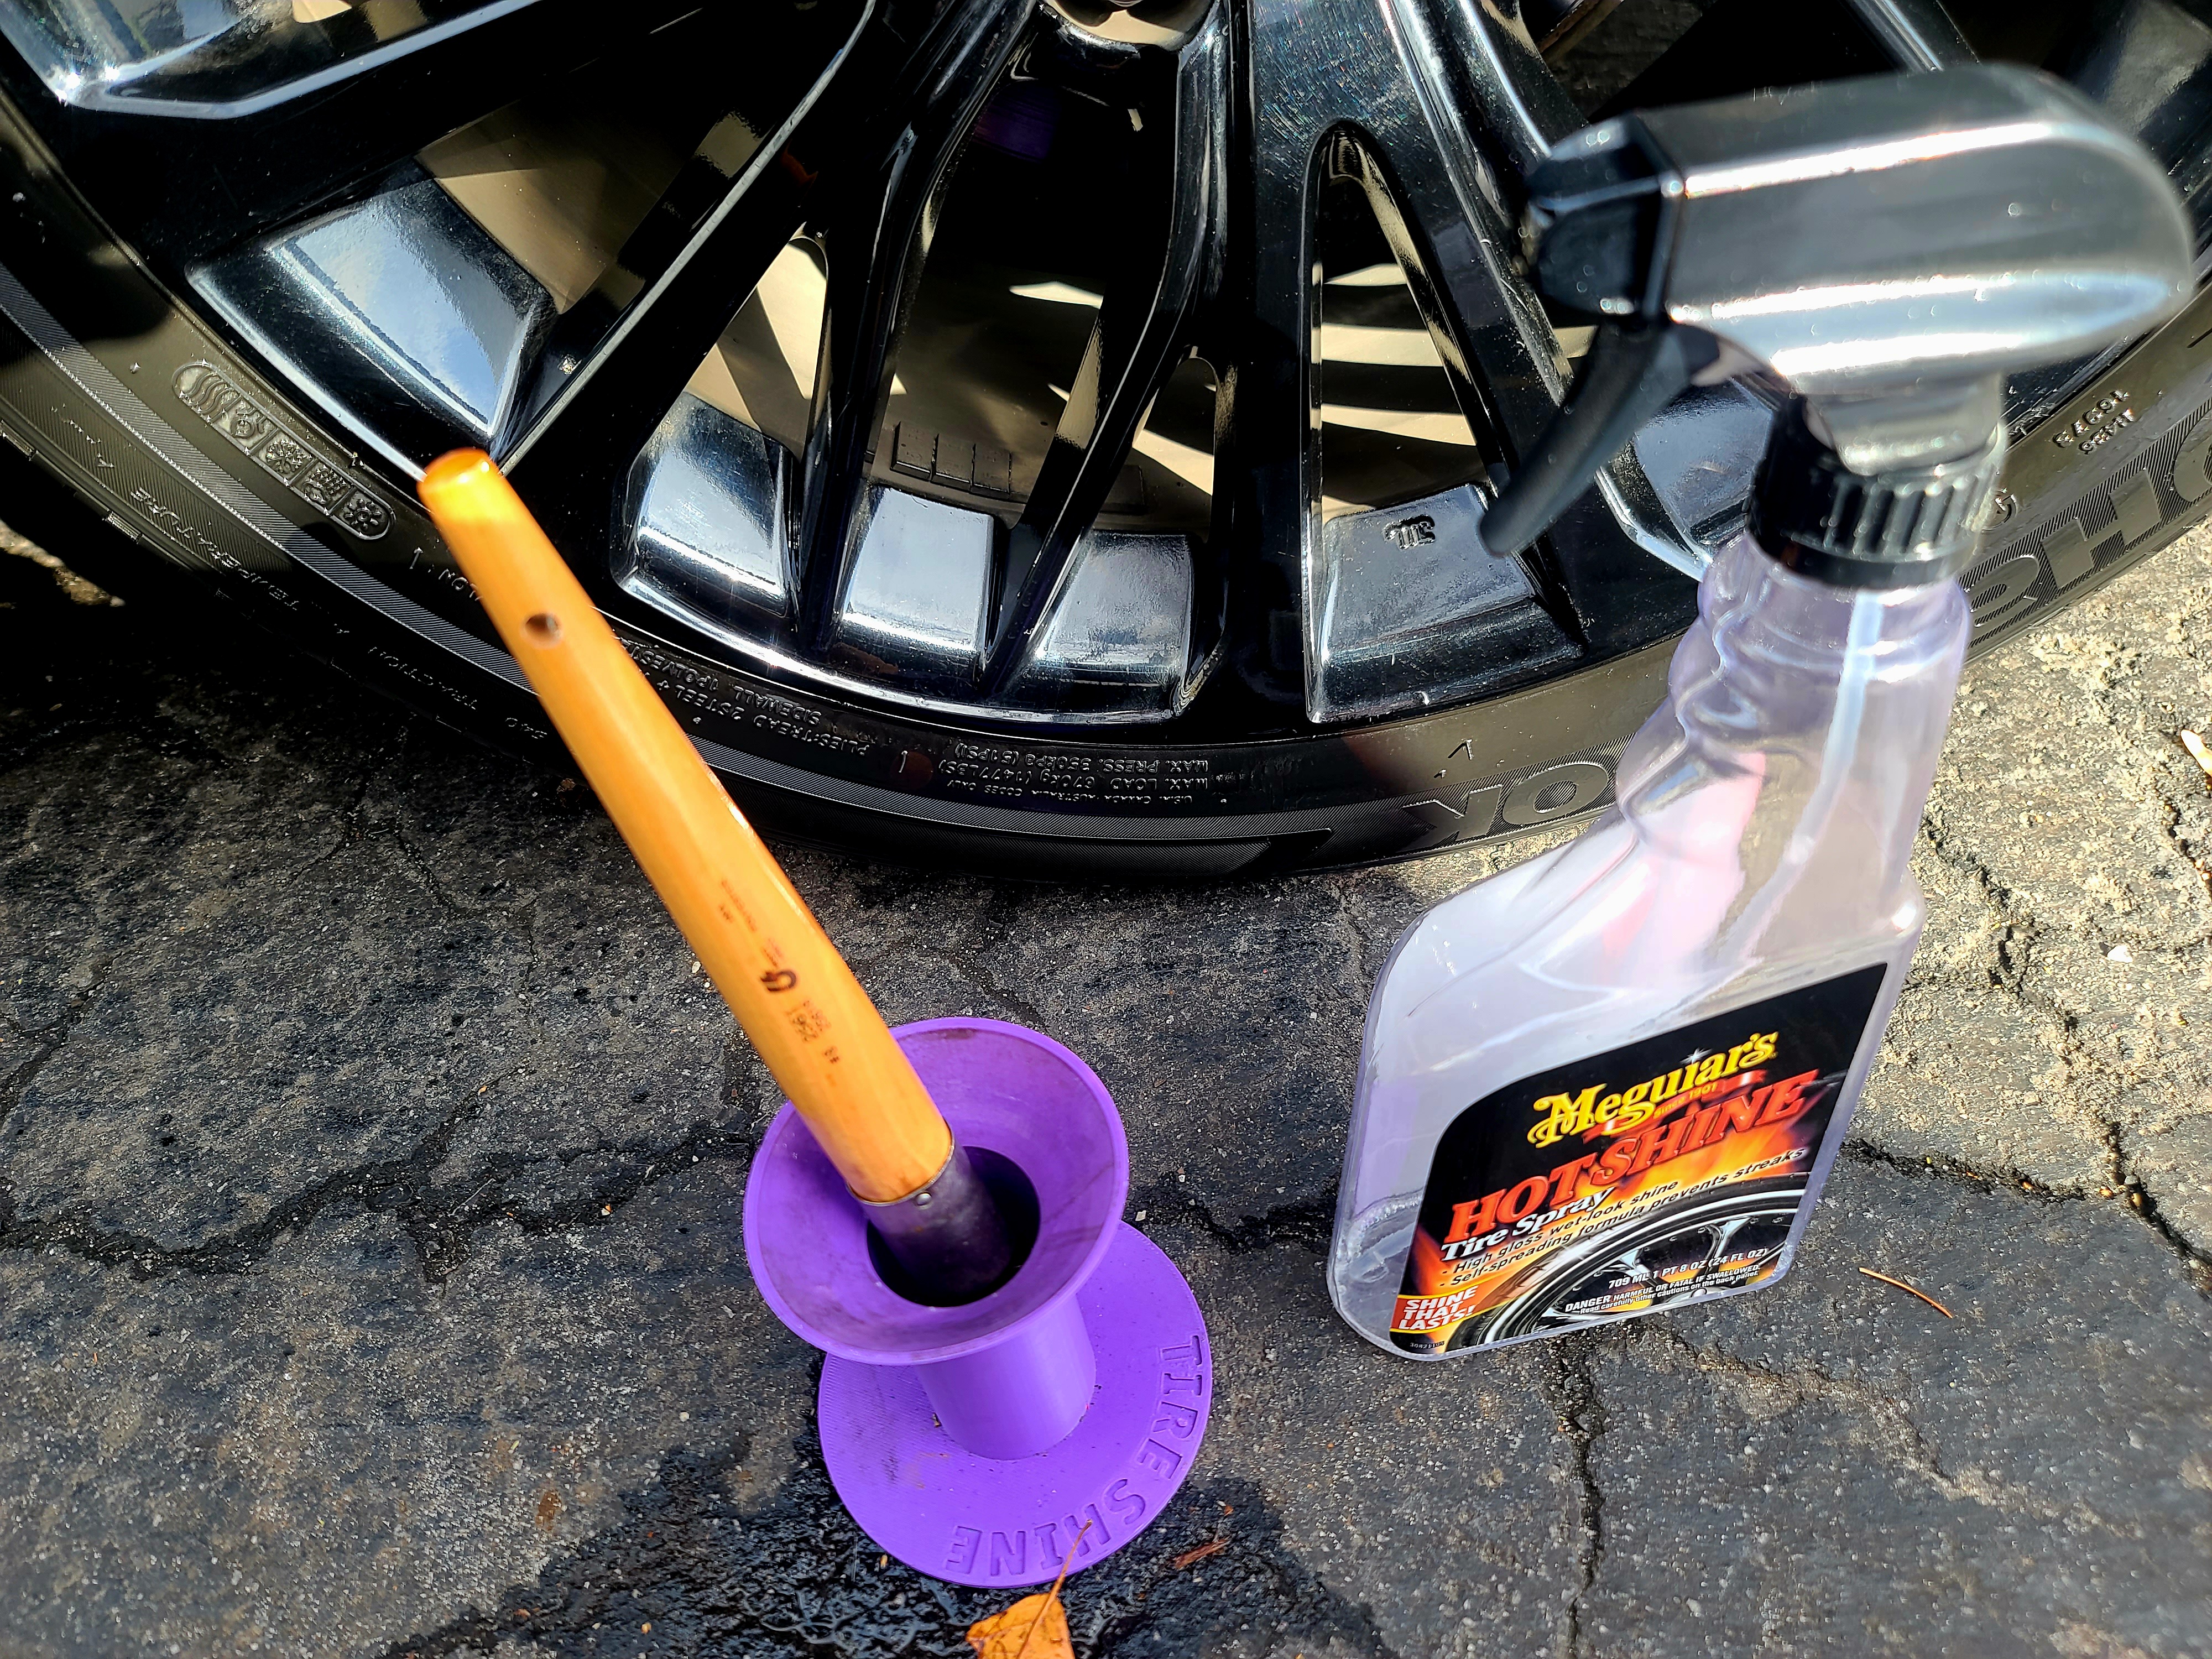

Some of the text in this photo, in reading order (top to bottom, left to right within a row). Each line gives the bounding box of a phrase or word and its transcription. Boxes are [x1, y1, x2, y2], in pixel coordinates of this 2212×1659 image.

[130, 487, 299, 611] TEMPERATURE
[368, 646, 477, 710] TRACTION
[733, 686, 822, 726] SIDEWALL
[947, 780, 977, 792] ONLY
[1040, 768, 1095, 790] 670kg
[1099, 759, 1160, 774] PRESS.
[1110, 777, 1158, 791] LOAD
[1165, 760, 1209, 774] MAX.
[1165, 777, 1208, 791] MAX.
[984, 784, 1022, 797] CODES
[1527, 1031, 1779, 1149] Meguiar's
[1689, 1082, 1718, 1099] 1901
[1444, 1069, 1819, 1244] HOT SHINE
[1441, 1186, 1617, 1261] Tire Spray
[1451, 1147, 1806, 1285] Self-spreading formula prevents streaks
[1454, 1181, 1678, 1274] High gloss wet-look shine
[1565, 1295, 1611, 1312] DANGER
[1613, 1287, 1654, 1301] HARMFUL
[1669, 1278, 1694, 1289] FATAL
[1704, 1264, 1761, 1281] SWALLOWED.
[1608, 1276, 1629, 1289] 709
[1631, 1272, 1649, 1284] ML
[1662, 1265, 1680, 1277] PT
[1689, 1260, 1707, 1271] OZ
[1708, 1256, 1728, 1272] (24
[1730, 1253, 1745, 1262] FL
[1746, 1248, 1769, 1261] OZ)
[1403, 1301, 1464, 1320] THAT
[1405, 1285, 1479, 1311] SHINE
[1580, 1306, 1600, 1314] Read
[1600, 1297, 1635, 1311] carefully
[1636, 1293, 1657, 1302] other
[1657, 1285, 1690, 1298] cautions
[1715, 1276, 1735, 1286] back
[1735, 1270, 1759, 1282] panel.
[1398, 1305, 1476, 1330] LASTS!
[946, 1334, 1204, 1578] TIRE SHINE
